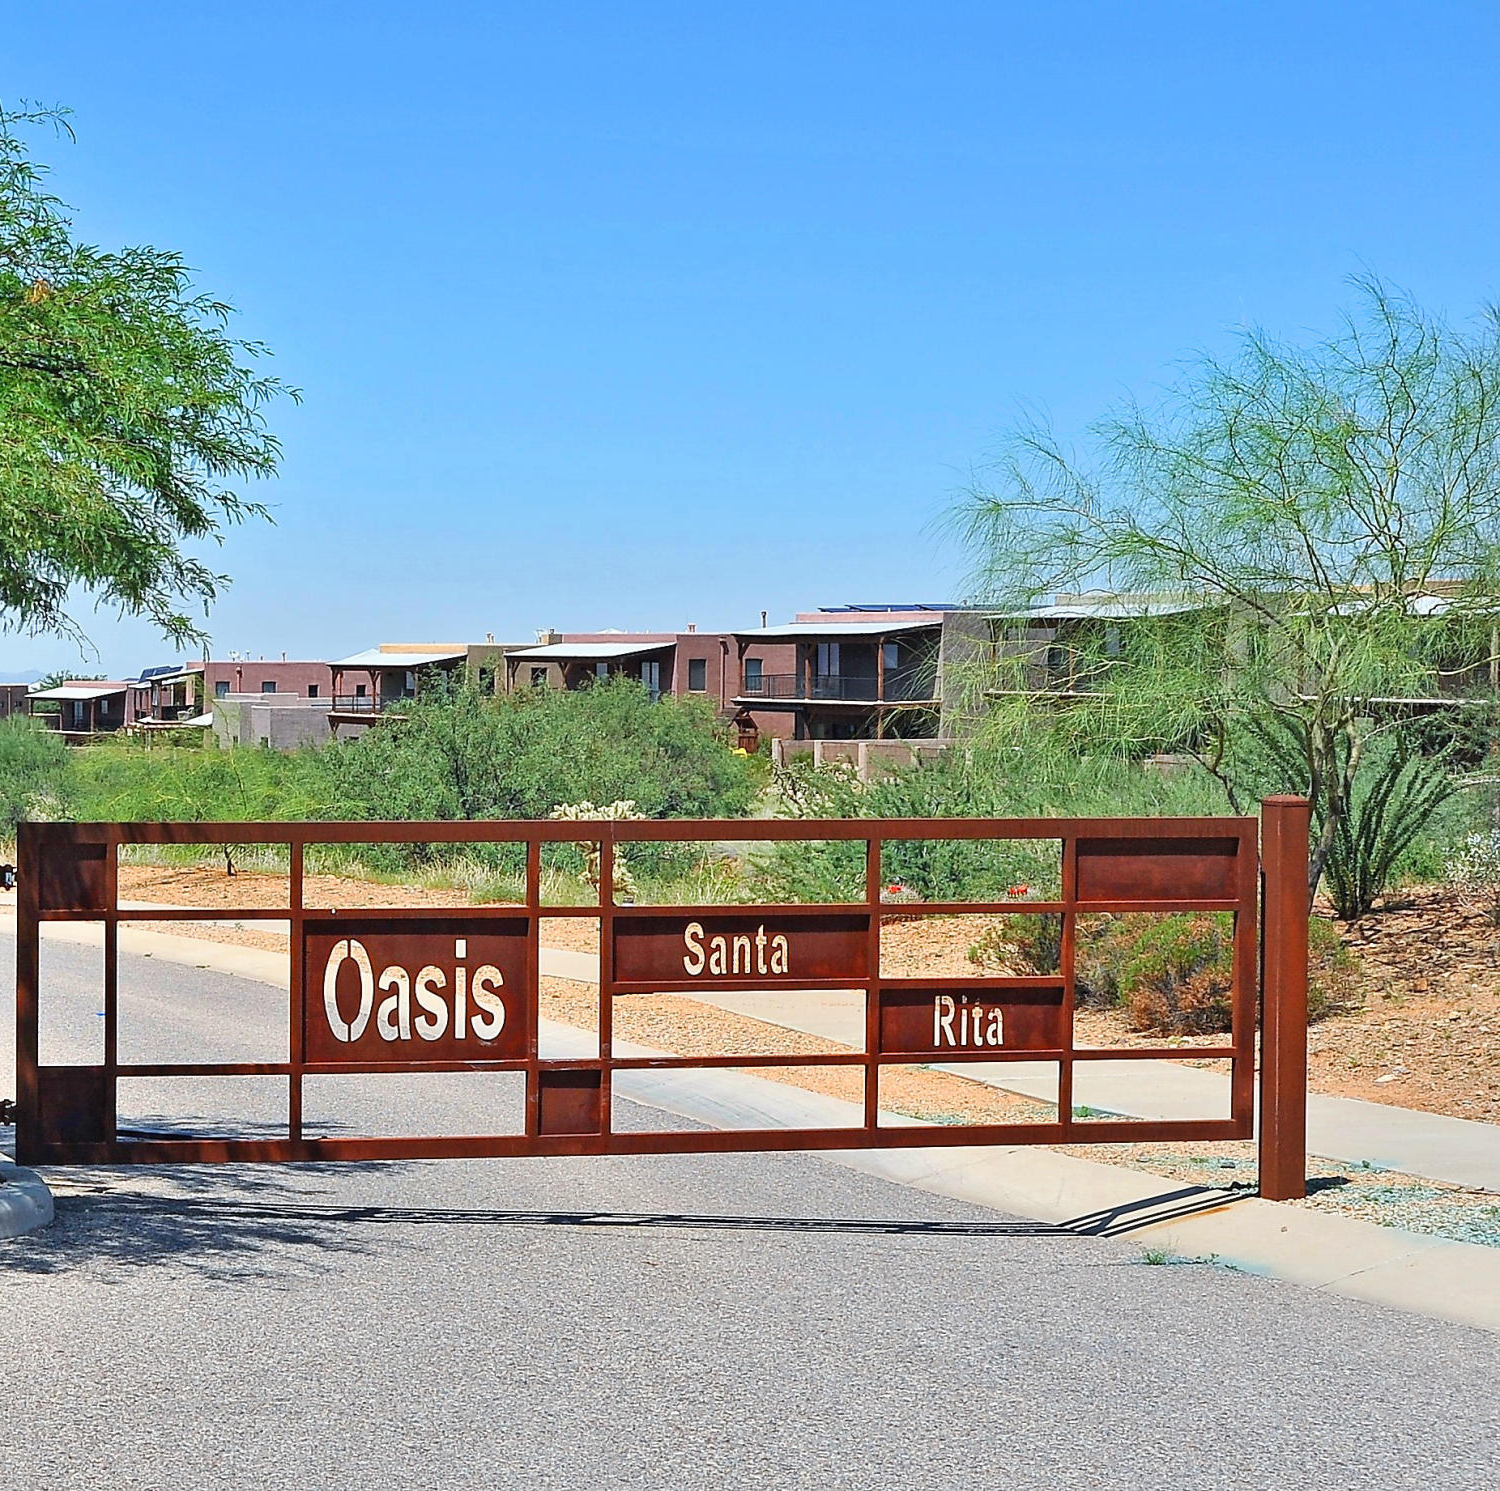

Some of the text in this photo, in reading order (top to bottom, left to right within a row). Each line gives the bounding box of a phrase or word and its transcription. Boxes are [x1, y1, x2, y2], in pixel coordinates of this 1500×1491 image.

[683, 922, 789, 976] Santa
[323, 938, 506, 1042] Oasis
[933, 995, 1004, 1047] Rita
